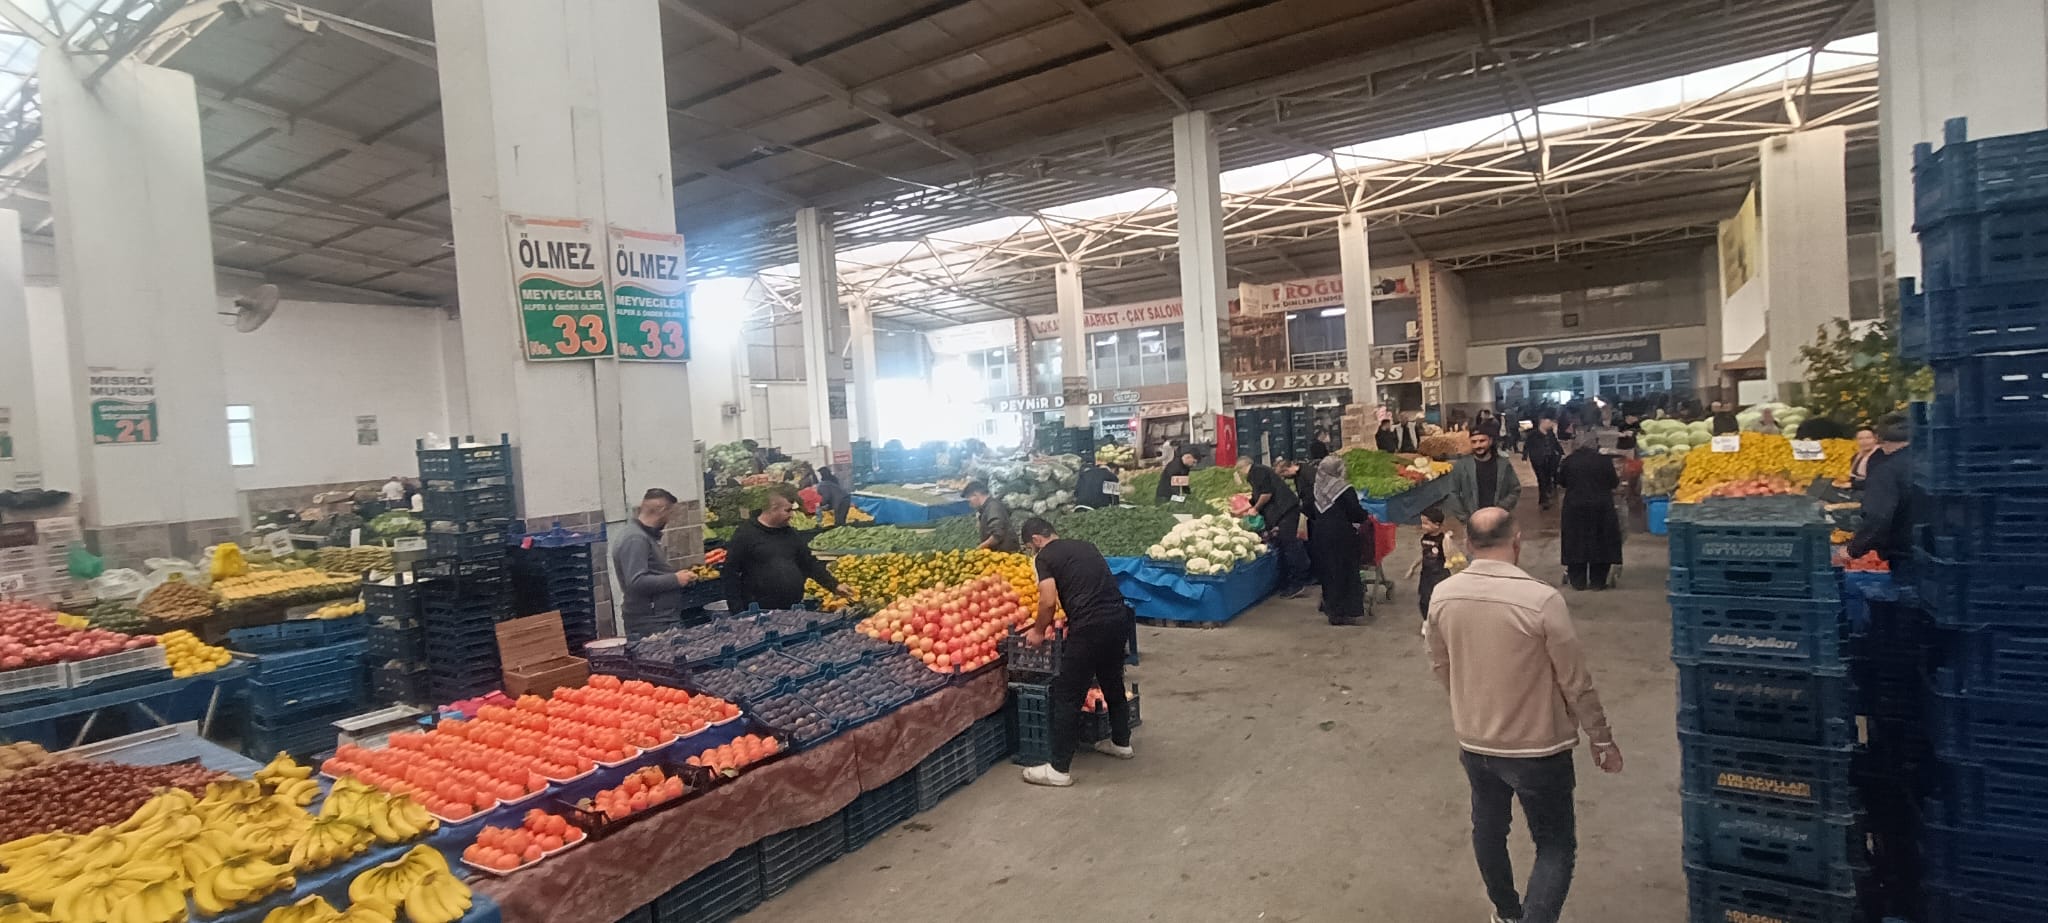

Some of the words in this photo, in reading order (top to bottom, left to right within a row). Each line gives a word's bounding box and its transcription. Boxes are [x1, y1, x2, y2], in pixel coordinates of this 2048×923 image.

[518, 233, 595, 269] ÖLMEZ
[616, 244, 680, 280] ÖLMEZ
[1126, 310, 1145, 327] ÇAY
[552, 314, 608, 355] 33
[639, 320, 686, 357] 33
[1558, 354, 1583, 366] KÖY
[1586, 352, 1633, 364] PAZARI
[1283, 366, 1404, 390] EXPRSS
[115, 419, 151, 441] 21
